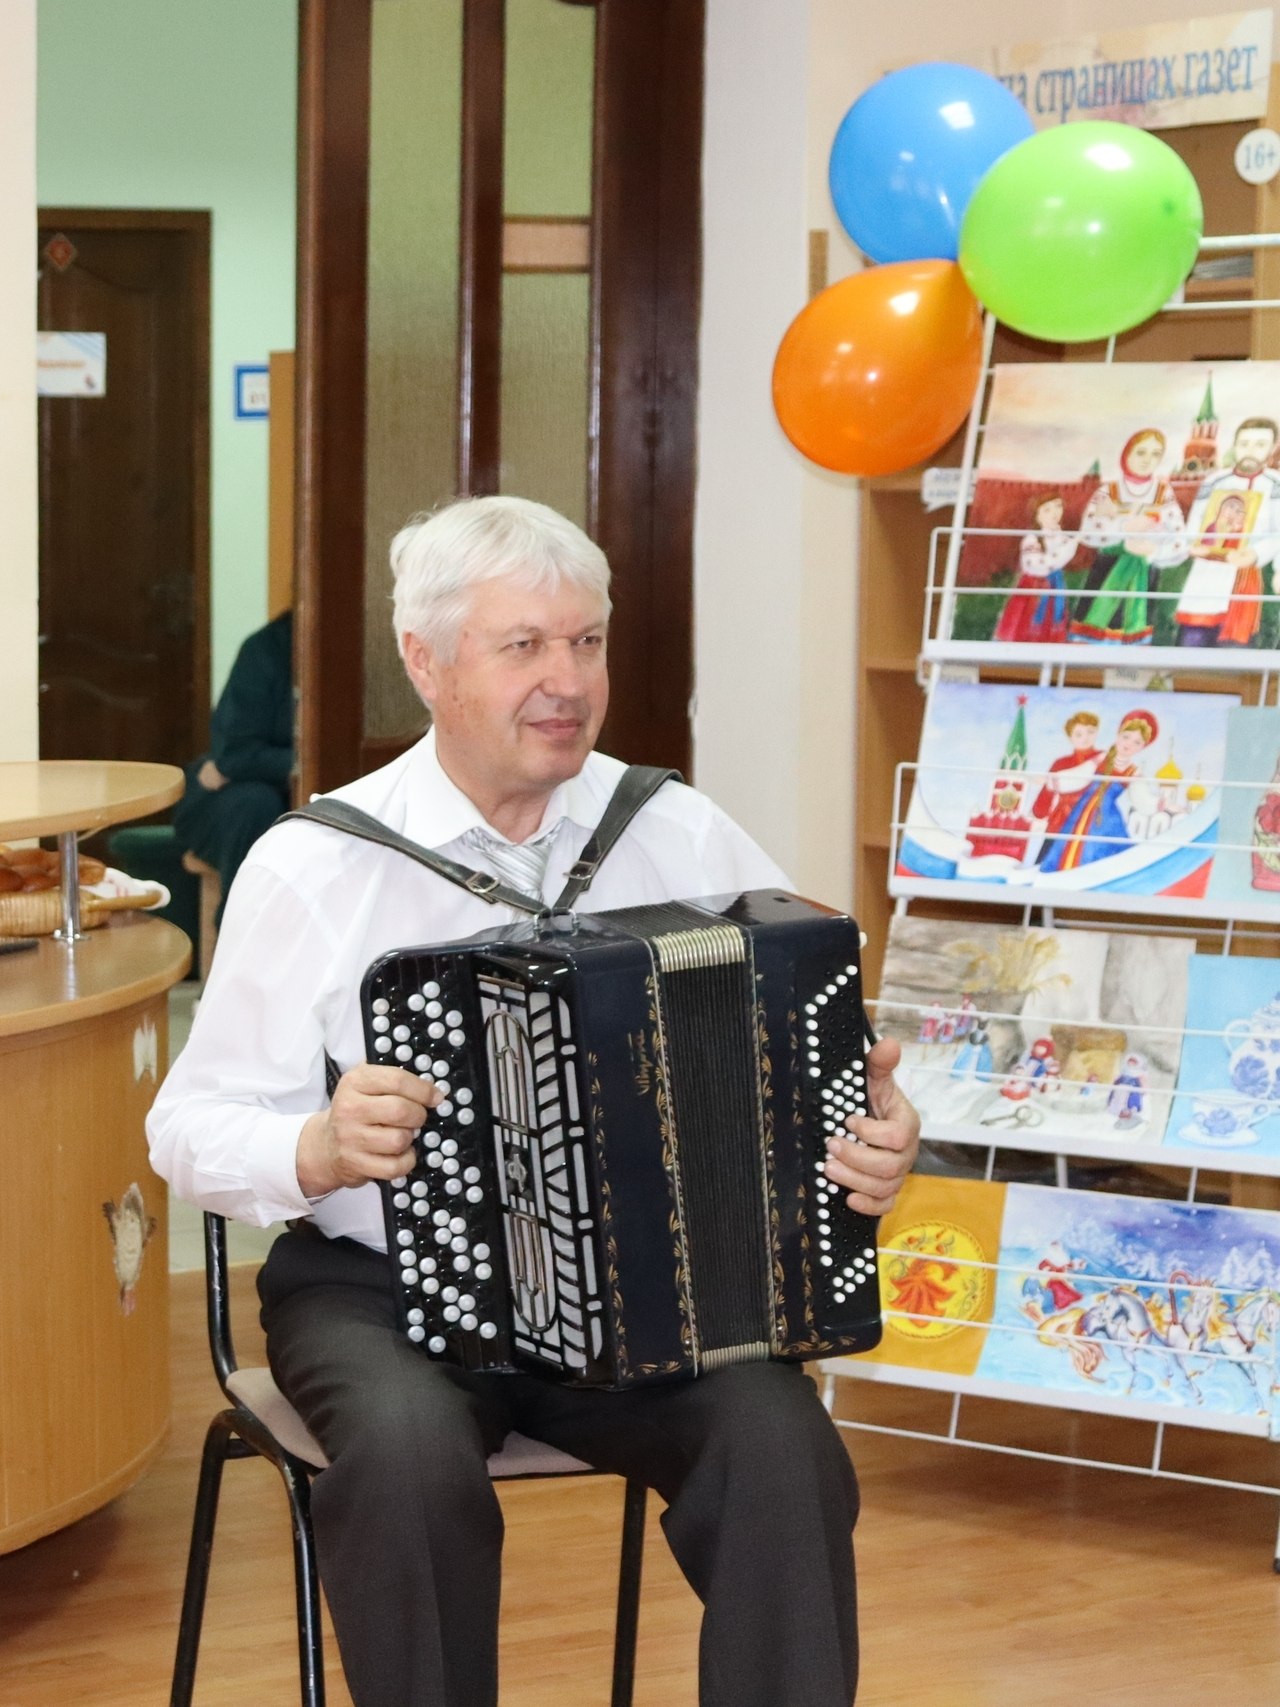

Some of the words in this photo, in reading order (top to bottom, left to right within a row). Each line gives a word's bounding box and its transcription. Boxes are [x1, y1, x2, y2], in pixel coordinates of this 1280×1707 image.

[1034, 54, 1176, 124] страницах
[1183, 45, 1258, 98] газет
[1244, 142, 1277, 170] 16+
